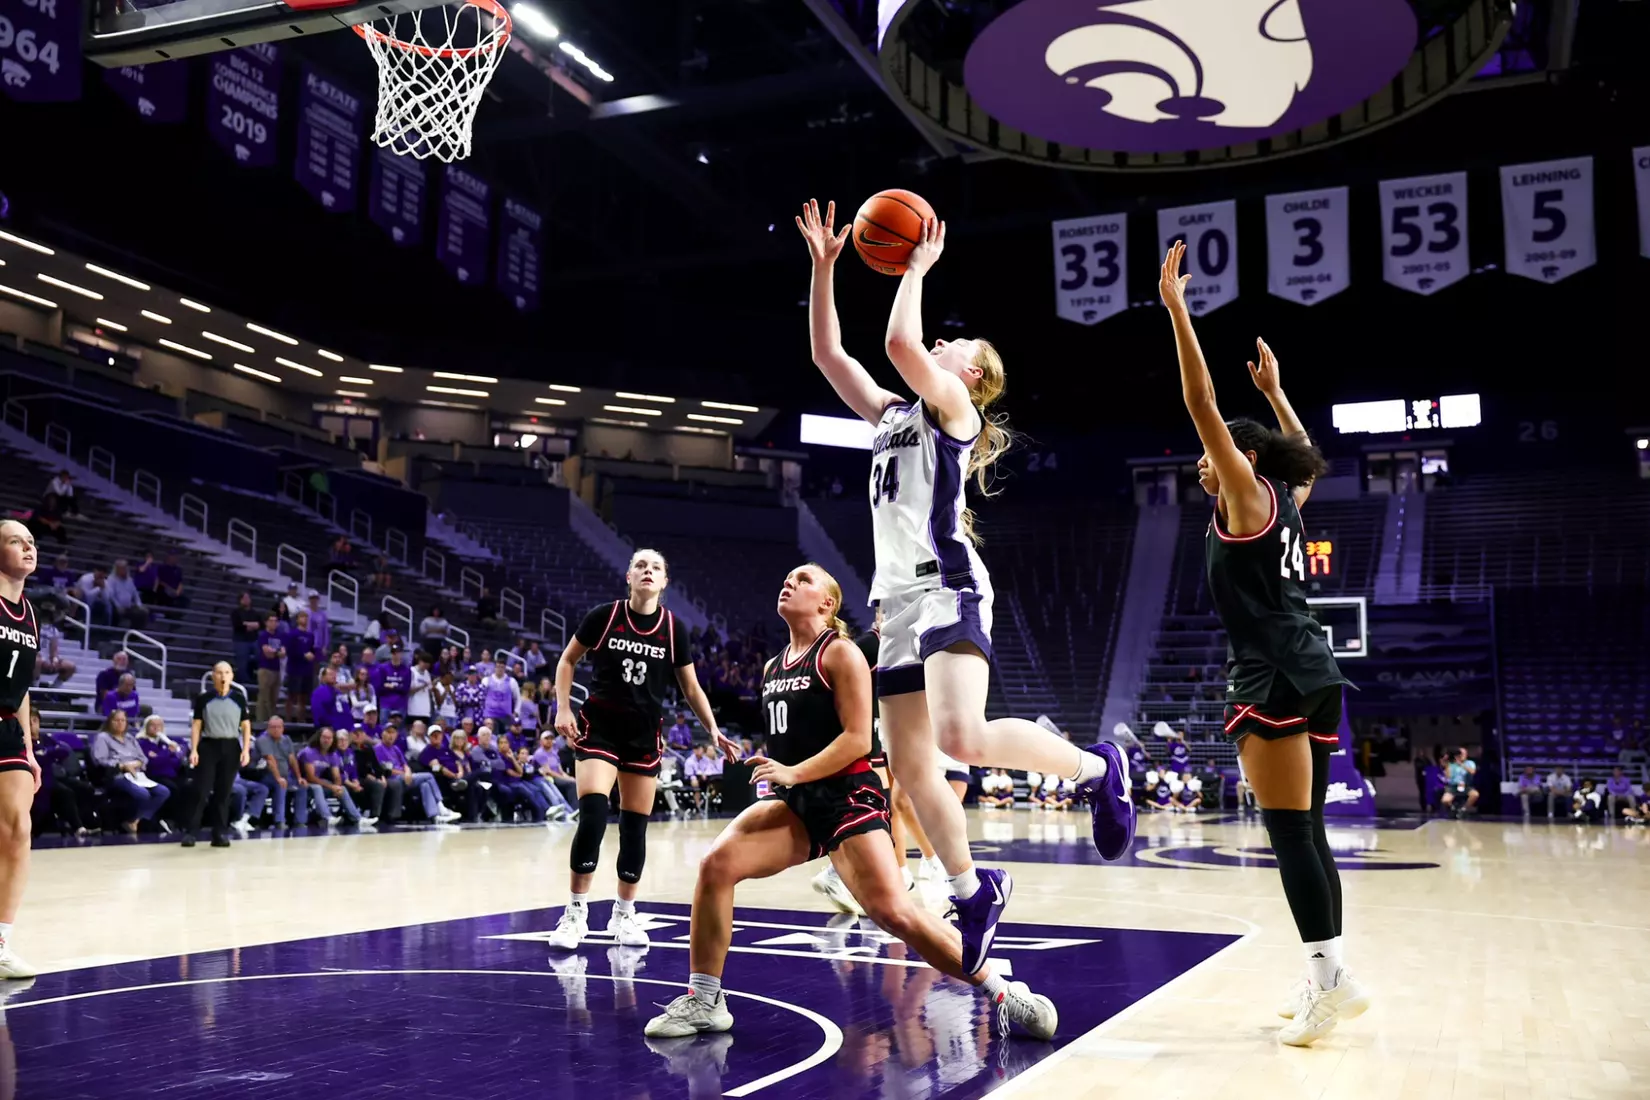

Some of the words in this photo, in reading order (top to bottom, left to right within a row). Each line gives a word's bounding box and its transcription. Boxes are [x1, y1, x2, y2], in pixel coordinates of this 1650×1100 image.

[0, 15, 60, 75] 964
[230, 54, 249, 75] BIG
[251, 67, 265, 84] 12
[203, 74, 278, 120] CHAMPIONS
[307, 72, 359, 113] K-STATE
[221, 104, 267, 144] 2019
[1393, 183, 1453, 200] WECKER
[1512, 168, 1581, 187] LEHNING
[1178, 213, 1214, 227] GARY
[1283, 198, 1330, 213] OHLDE
[1532, 189, 1566, 243] 5
[1059, 223, 1120, 240] ROMSTAD
[1292, 217, 1324, 267] 3
[1390, 202, 1460, 257] 53
[1060, 240, 1120, 290] 33
[1517, 420, 1559, 443] 26
[1027, 452, 1058, 472] 24
[873, 456, 899, 508] 34
[1281, 526, 1305, 581] 24
[1310, 555, 1330, 575] 17
[0, 626, 37, 649] OYOTES
[608, 637, 666, 659] COYOTES
[6, 650, 20, 679] 1
[622, 658, 647, 685] 33
[767, 700, 788, 735] 10
